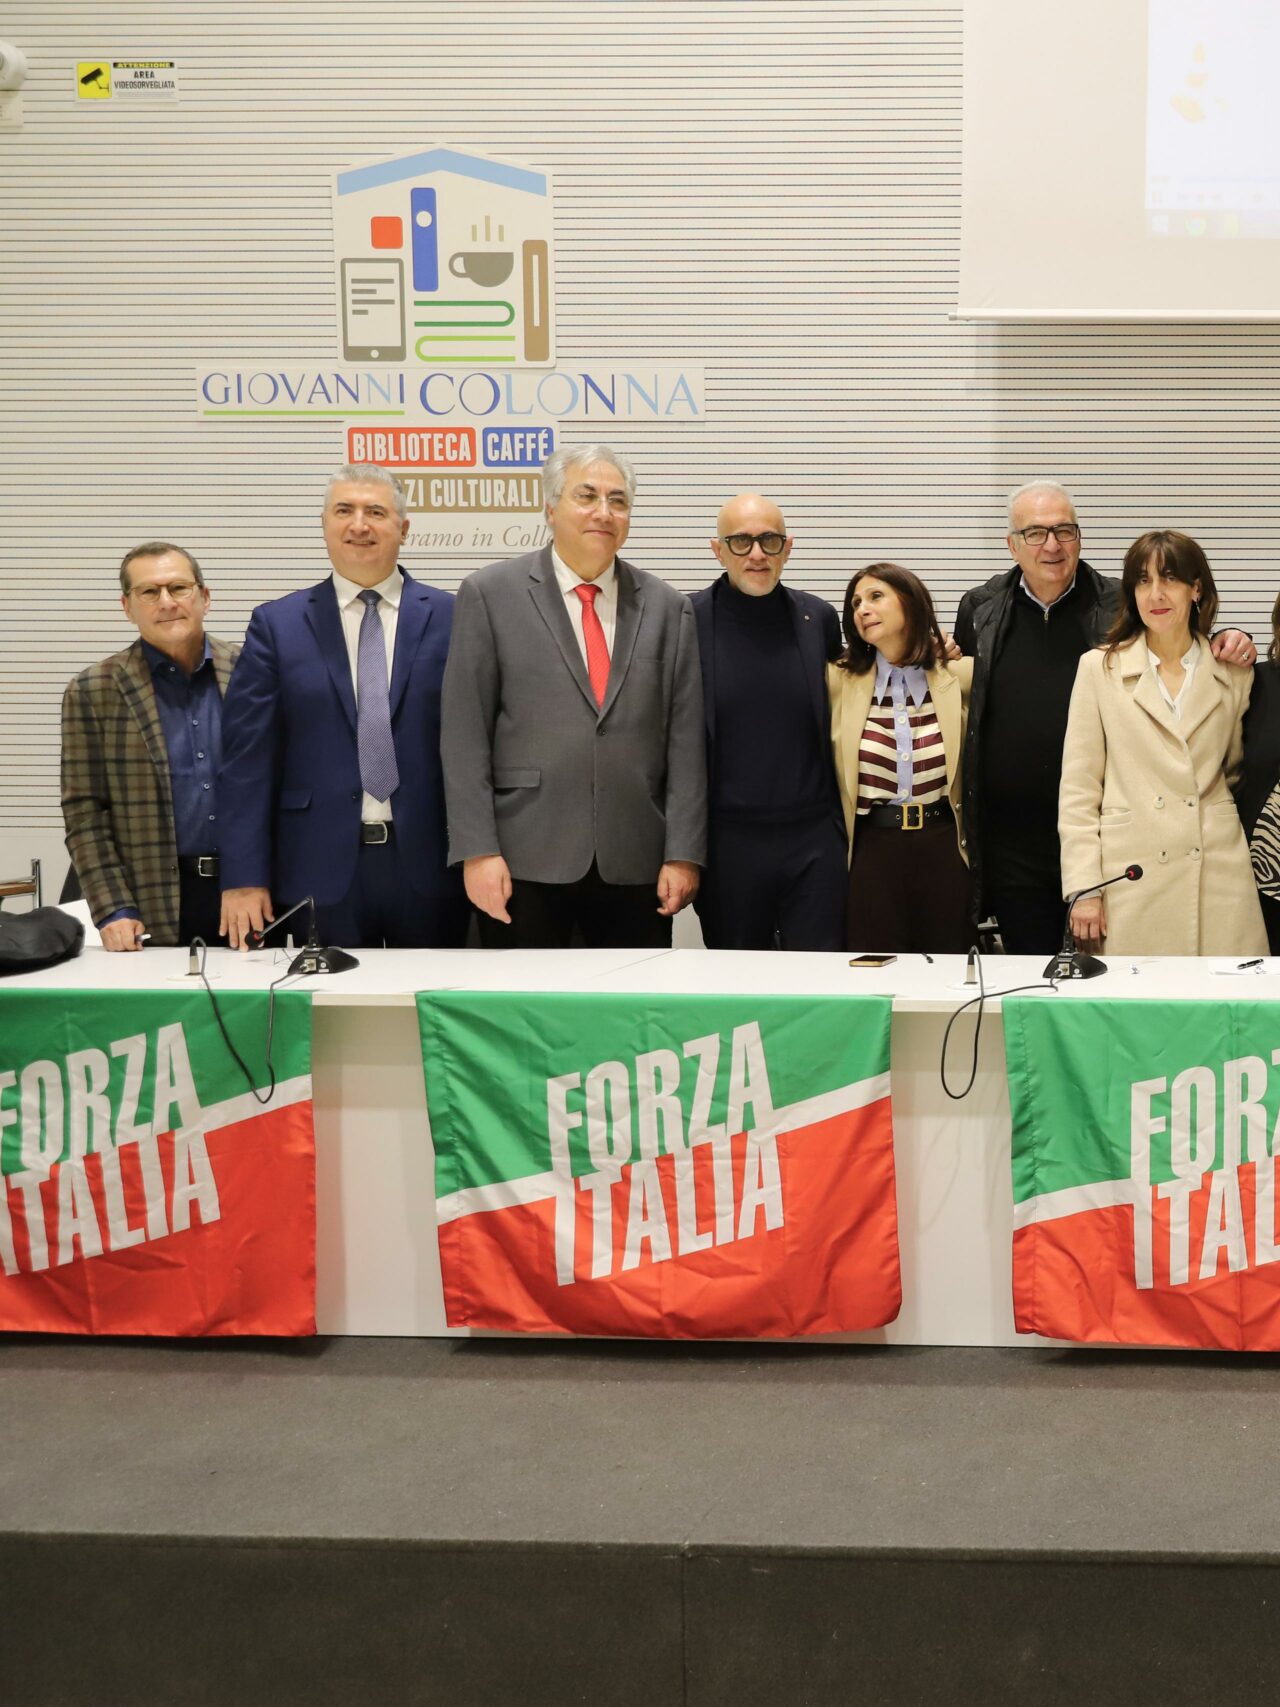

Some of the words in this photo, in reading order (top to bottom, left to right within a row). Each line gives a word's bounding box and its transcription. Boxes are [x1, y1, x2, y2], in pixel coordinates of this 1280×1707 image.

[114, 80, 176, 89] VIDEOSORVEGLIATA
[134, 71, 155, 79] AREA
[202, 372, 405, 405] GIOVANNI
[419, 372, 699, 415] COLONNA
[352, 432, 472, 462] BIBLIOTECA
[486, 428, 549, 462] CAFFÉ
[400, 479, 424, 507] ZI
[430, 478, 539, 508] CULTURALI
[472, 527, 493, 547] in
[547, 1021, 775, 1182] FORZA
[552, 1132, 785, 1287] ITALIA
